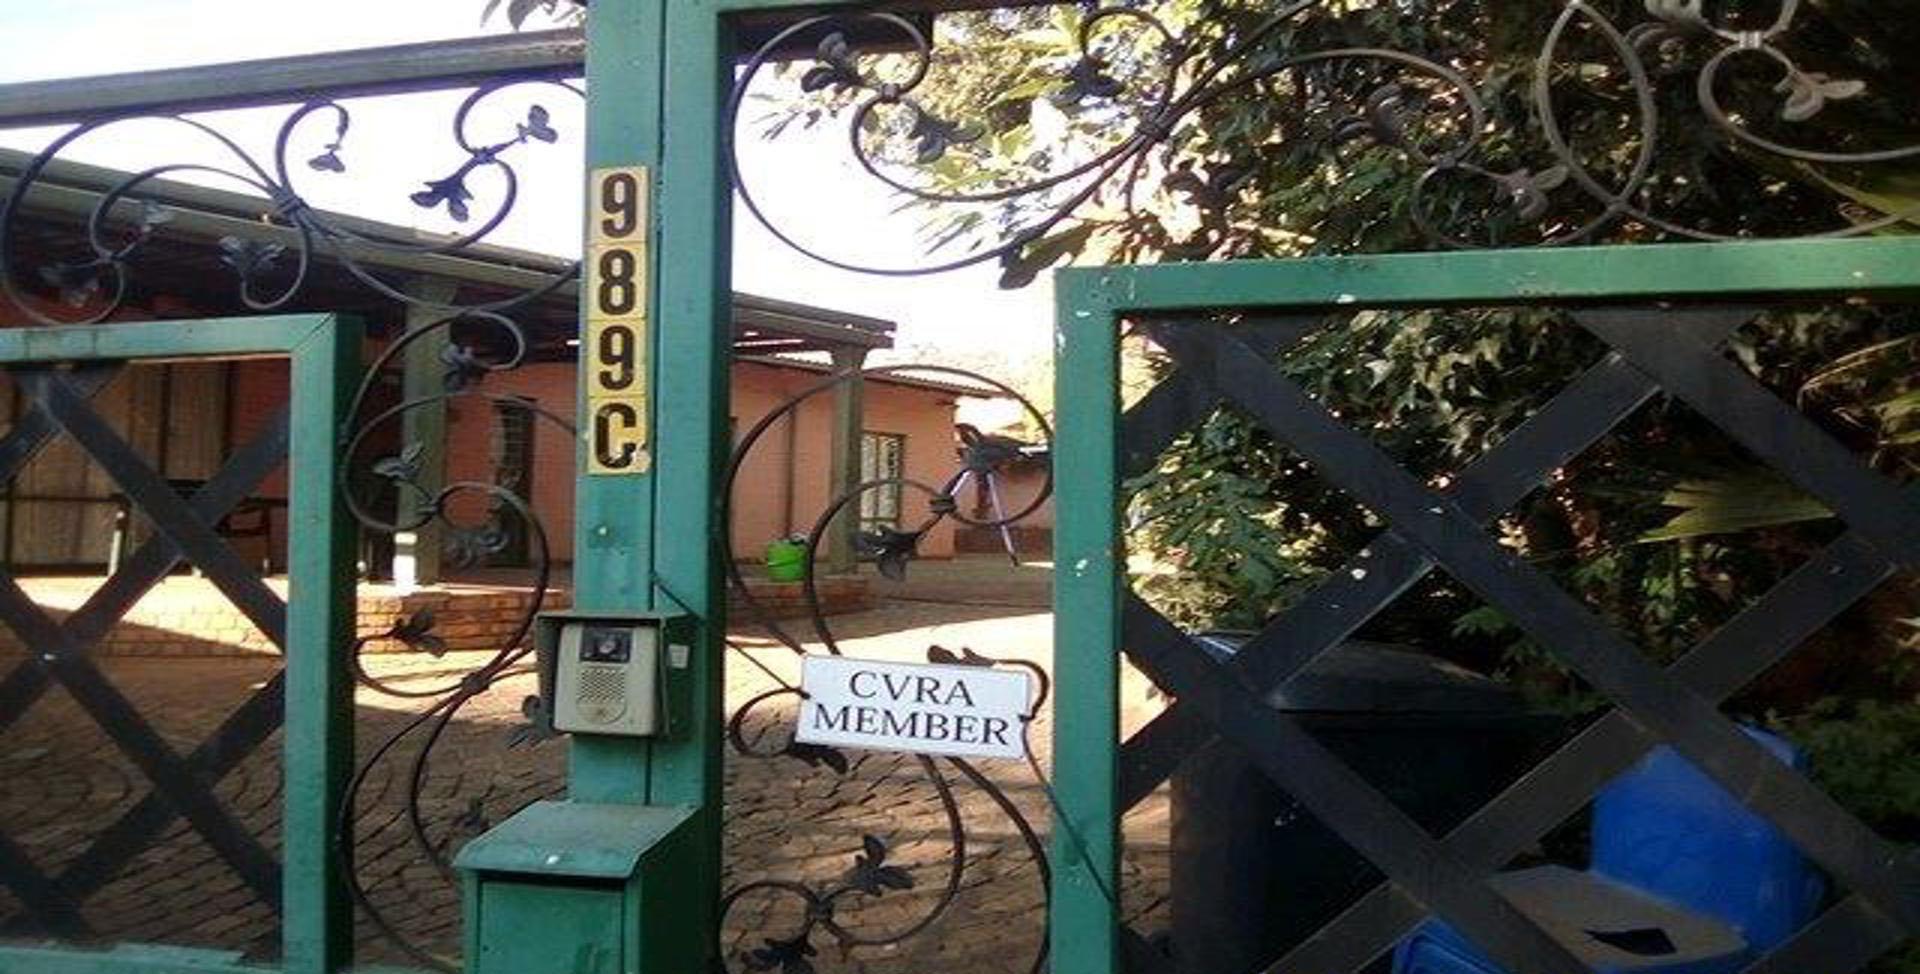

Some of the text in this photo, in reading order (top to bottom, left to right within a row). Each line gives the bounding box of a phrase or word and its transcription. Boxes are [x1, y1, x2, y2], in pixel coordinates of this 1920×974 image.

[595, 172, 637, 469] 989C
[850, 670, 975, 707] CVRA
[813, 703, 1009, 746] MEMBER
